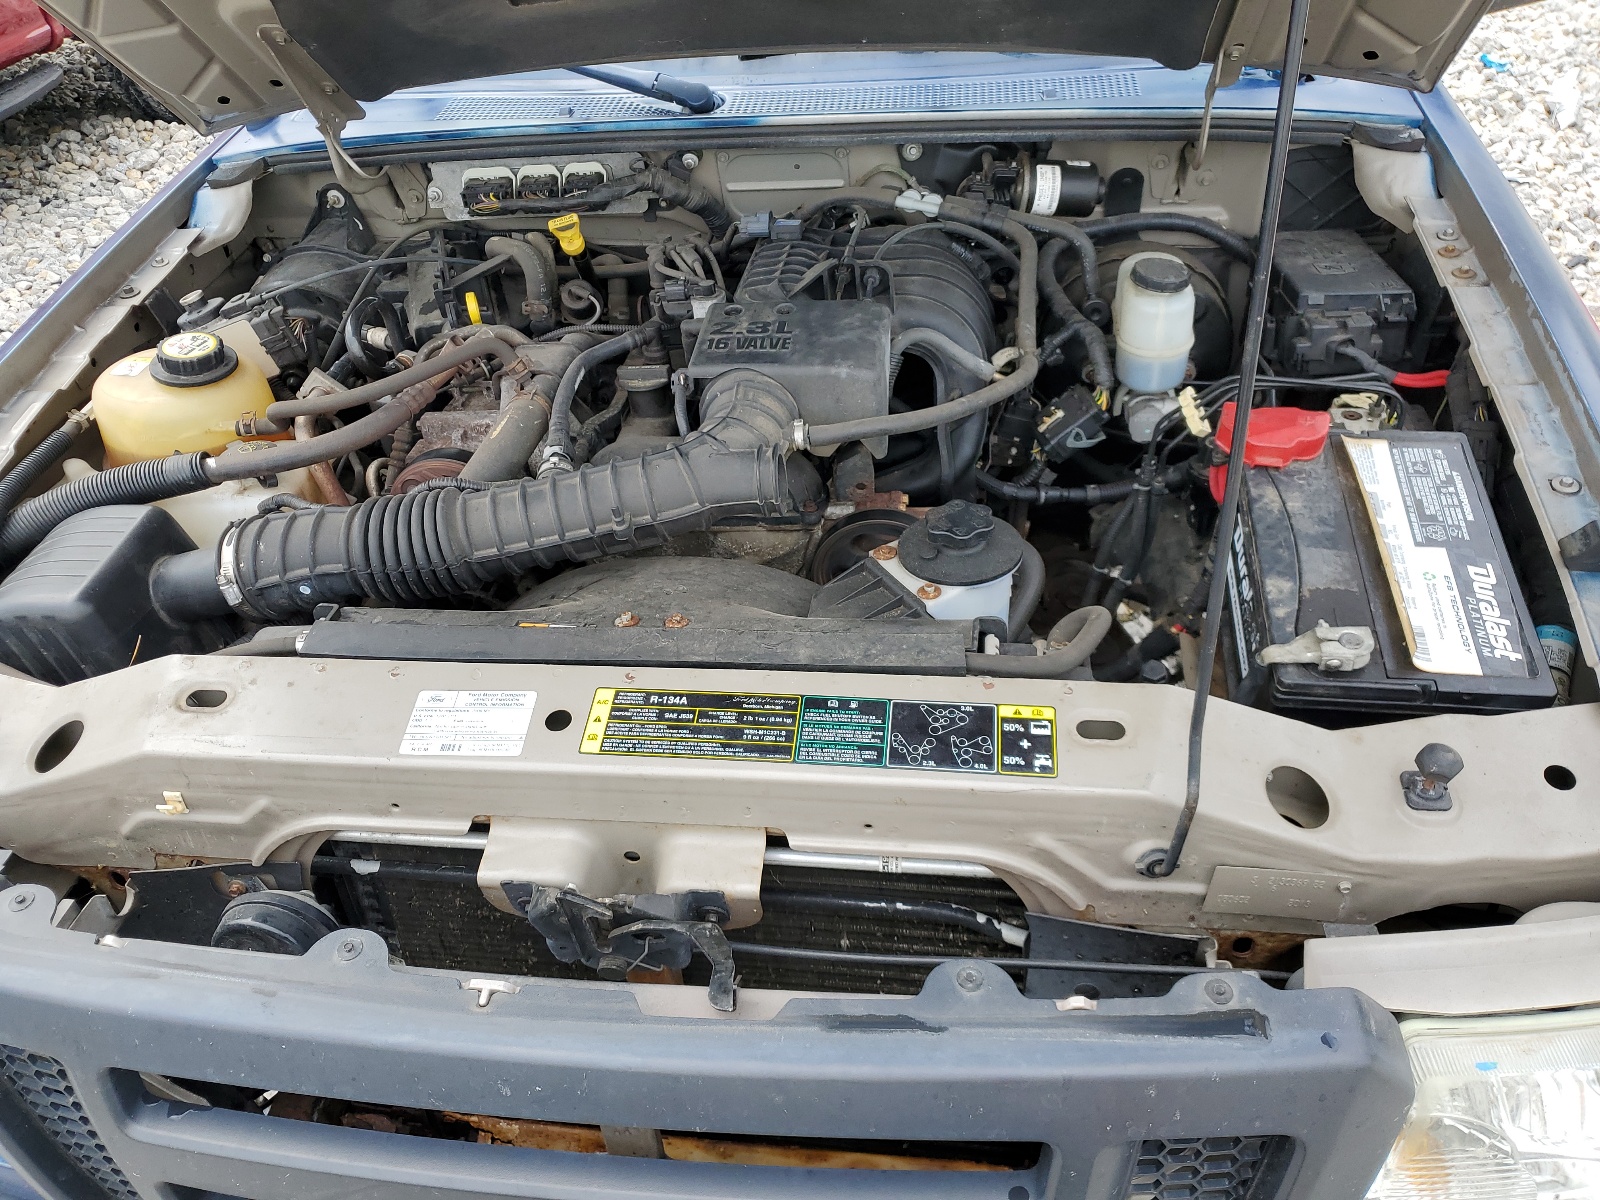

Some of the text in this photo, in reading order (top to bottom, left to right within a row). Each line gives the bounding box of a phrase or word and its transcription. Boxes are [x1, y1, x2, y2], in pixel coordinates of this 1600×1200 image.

[710, 321, 792, 335] 2.3L
[707, 337, 792, 350] 16 VALVE
[1444, 575, 1472, 654] EFB TECHNOLOGY
[1467, 562, 1522, 662] Duralast
[1466, 596, 1493, 658] PLATINUM
[650, 696, 688, 705] R-134A
[1003, 723, 1025, 732] 50%
[1003, 757, 1025, 766] 50%
